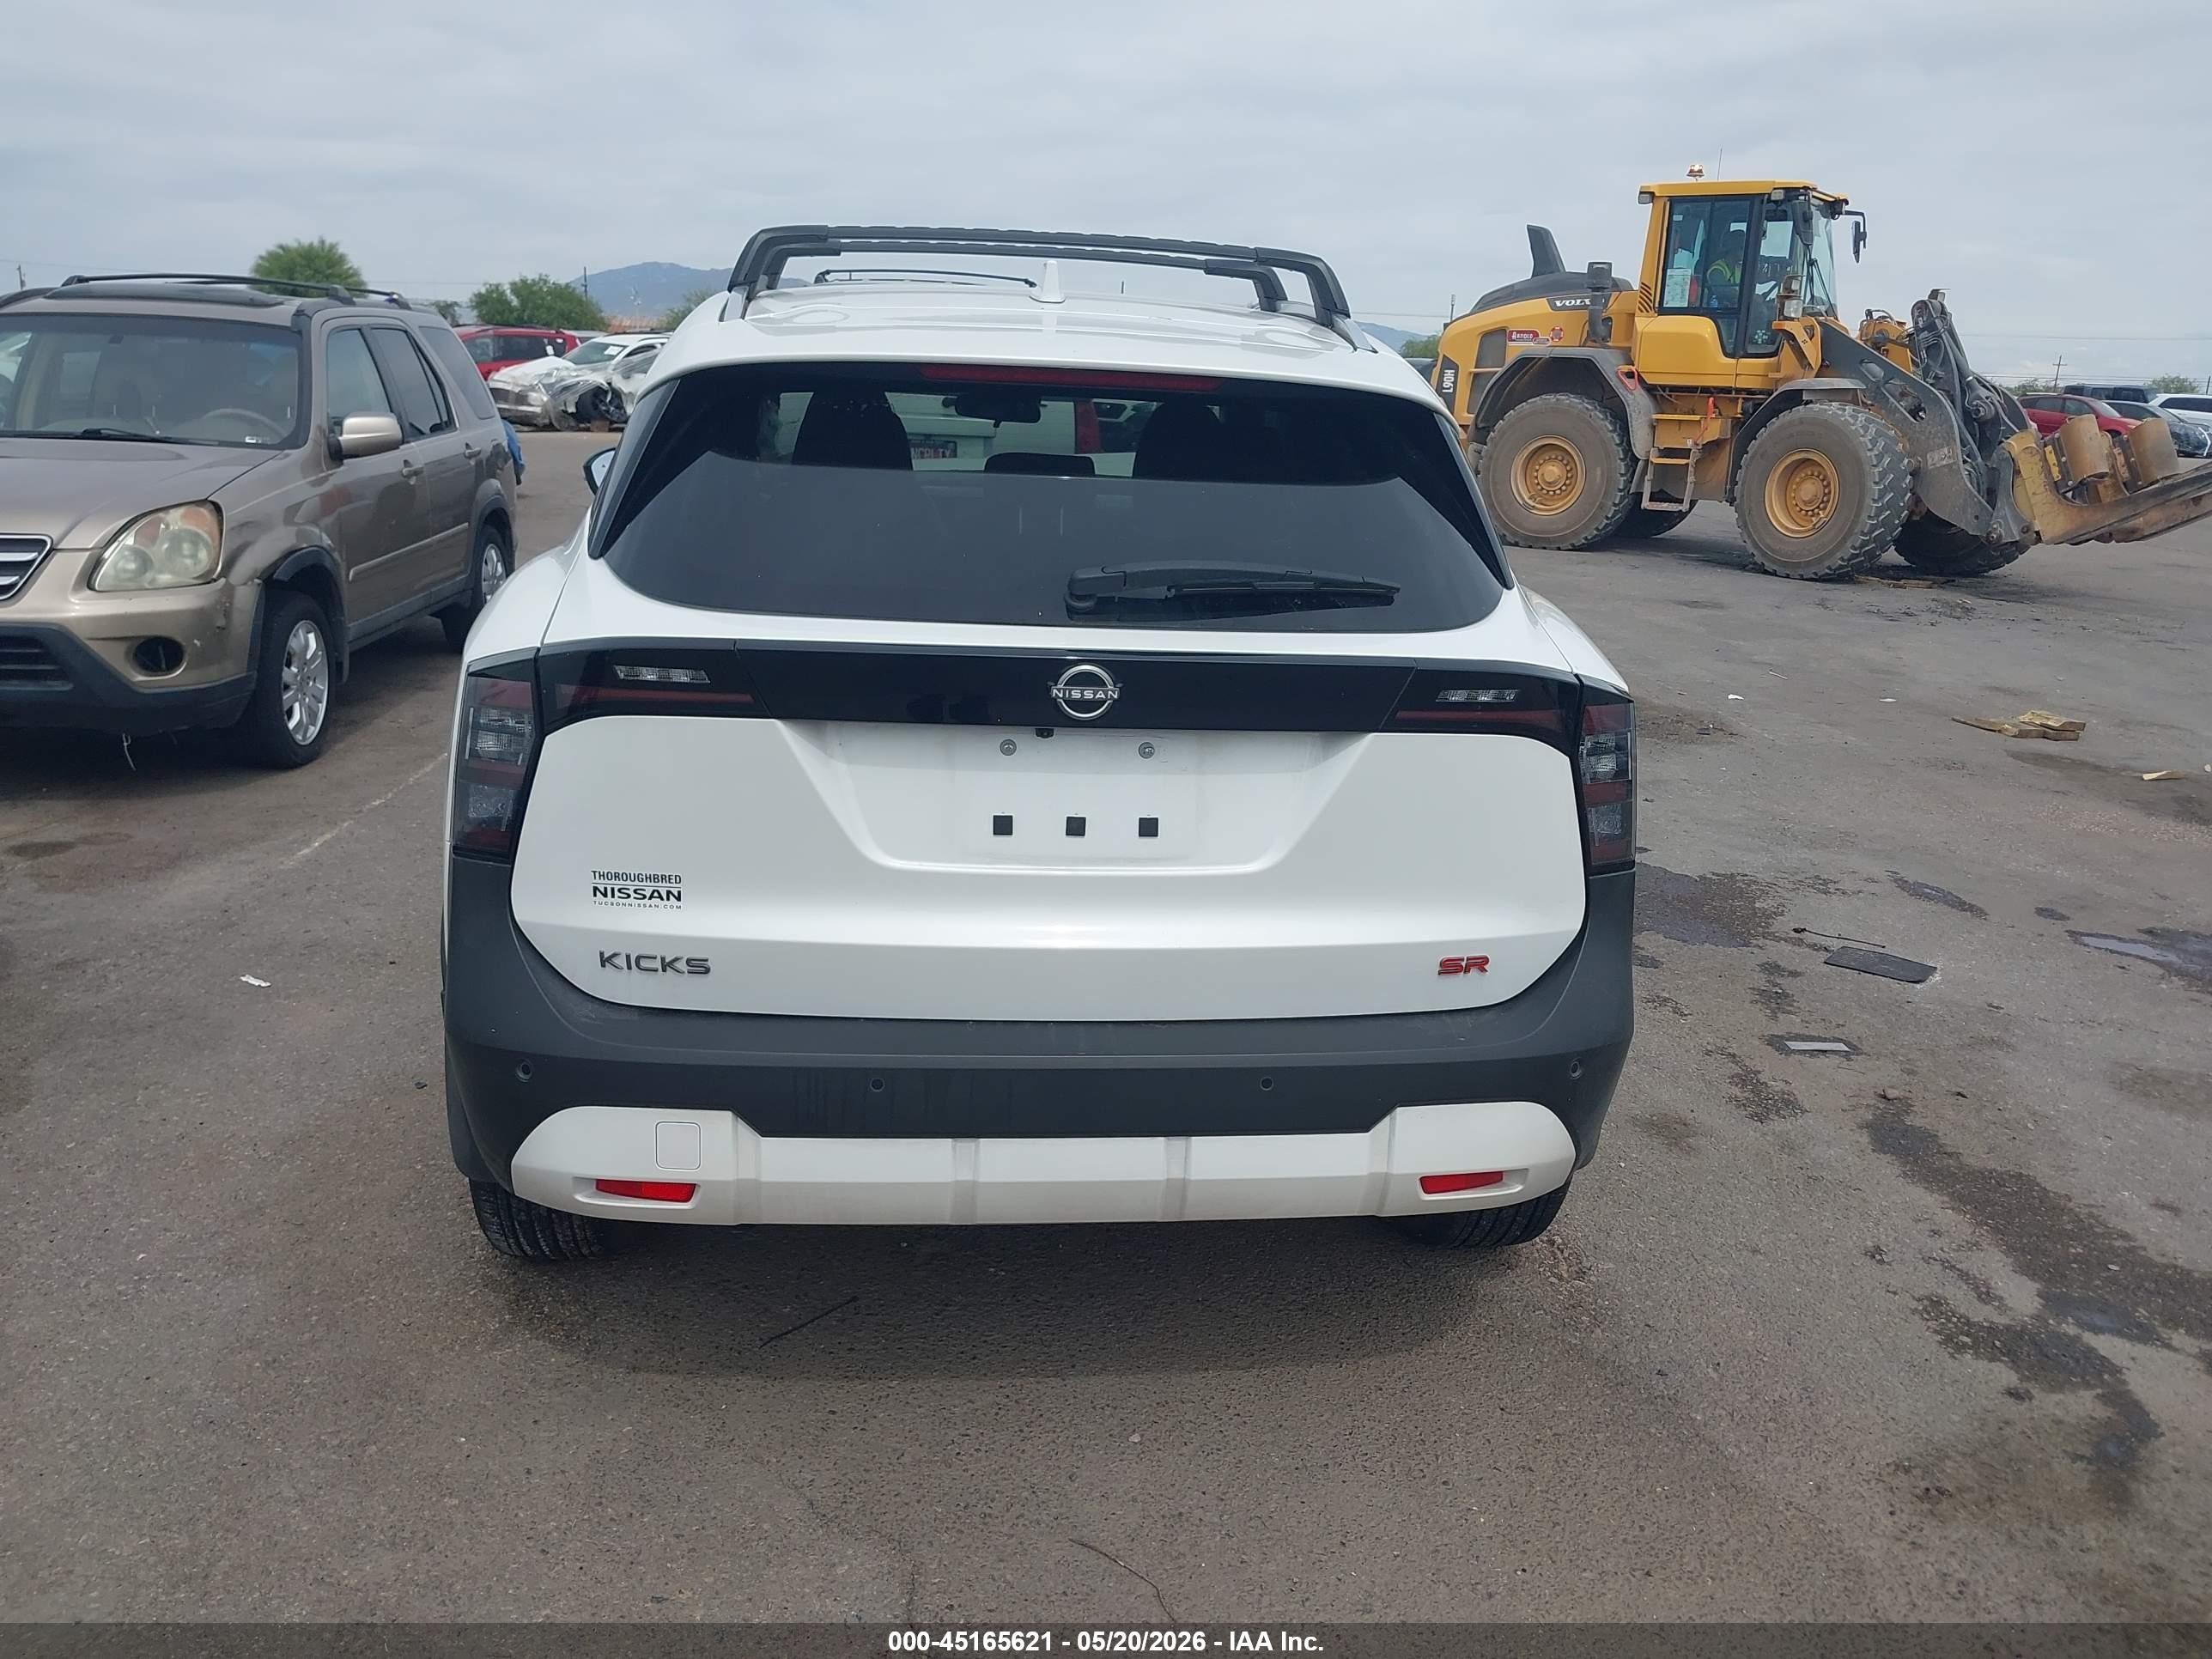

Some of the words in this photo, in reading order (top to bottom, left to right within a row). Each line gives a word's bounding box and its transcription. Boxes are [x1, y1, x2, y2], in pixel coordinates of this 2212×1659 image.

[1442, 369, 1455, 393] L90H
[1052, 689, 1118, 699] NISSAN
[591, 870, 682, 884] THOROUGHBRED
[592, 886, 682, 902] NISSAN
[592, 901, 682, 909] TUCSONNISSAN.COM
[599, 950, 711, 975] KICKS
[1437, 954, 1490, 975] SR
